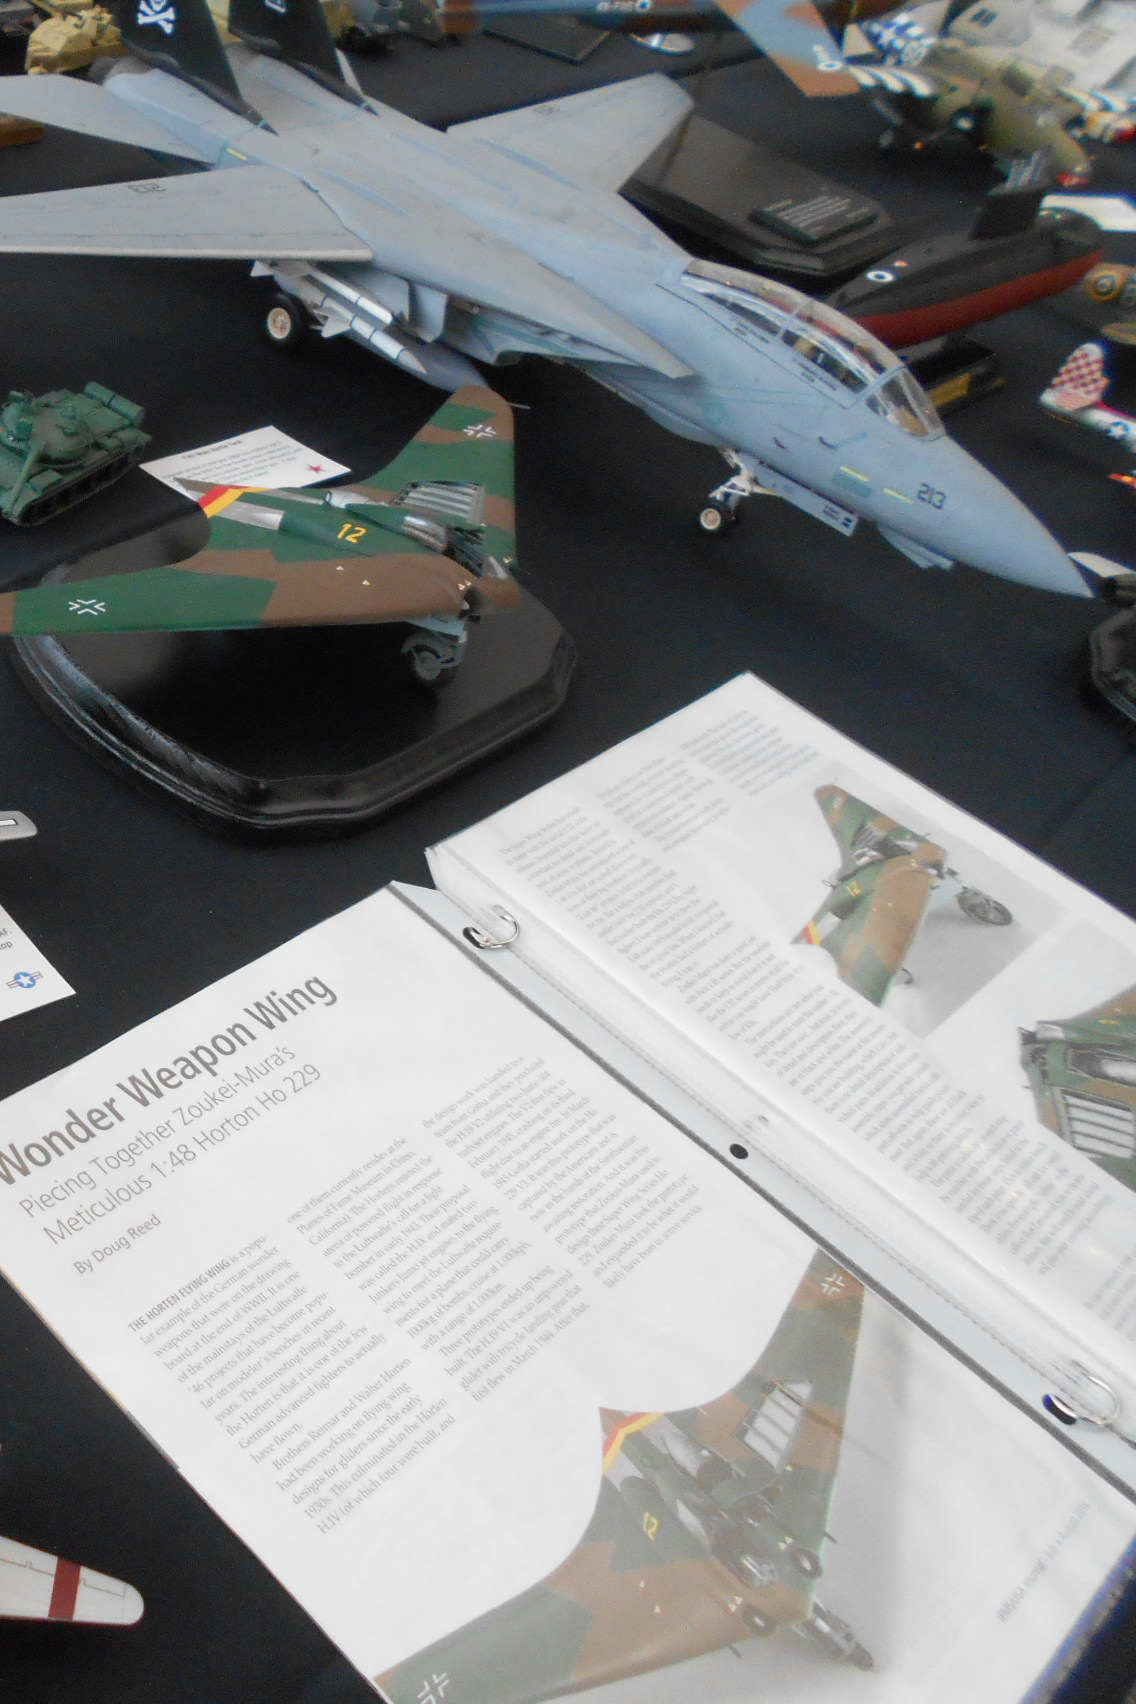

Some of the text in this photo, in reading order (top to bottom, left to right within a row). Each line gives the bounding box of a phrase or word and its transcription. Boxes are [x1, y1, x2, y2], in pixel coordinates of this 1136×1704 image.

[917, 483, 946, 510] 213
[337, 523, 368, 543] 12
[115, 1022, 257, 1107] Weapon
[242, 976, 337, 1030] Wing
[18, 1046, 296, 1218] Piecing Together Zoukei-Mura's
[42, 1063, 321, 1245] Meticulous 1:48 Horton Ho 229
[72, 1212, 161, 1274] By Doug Reed
[144, 1293, 181, 1320] HORTEN
[177, 1274, 208, 1298] FLYING
[205, 1259, 231, 1279] WING
